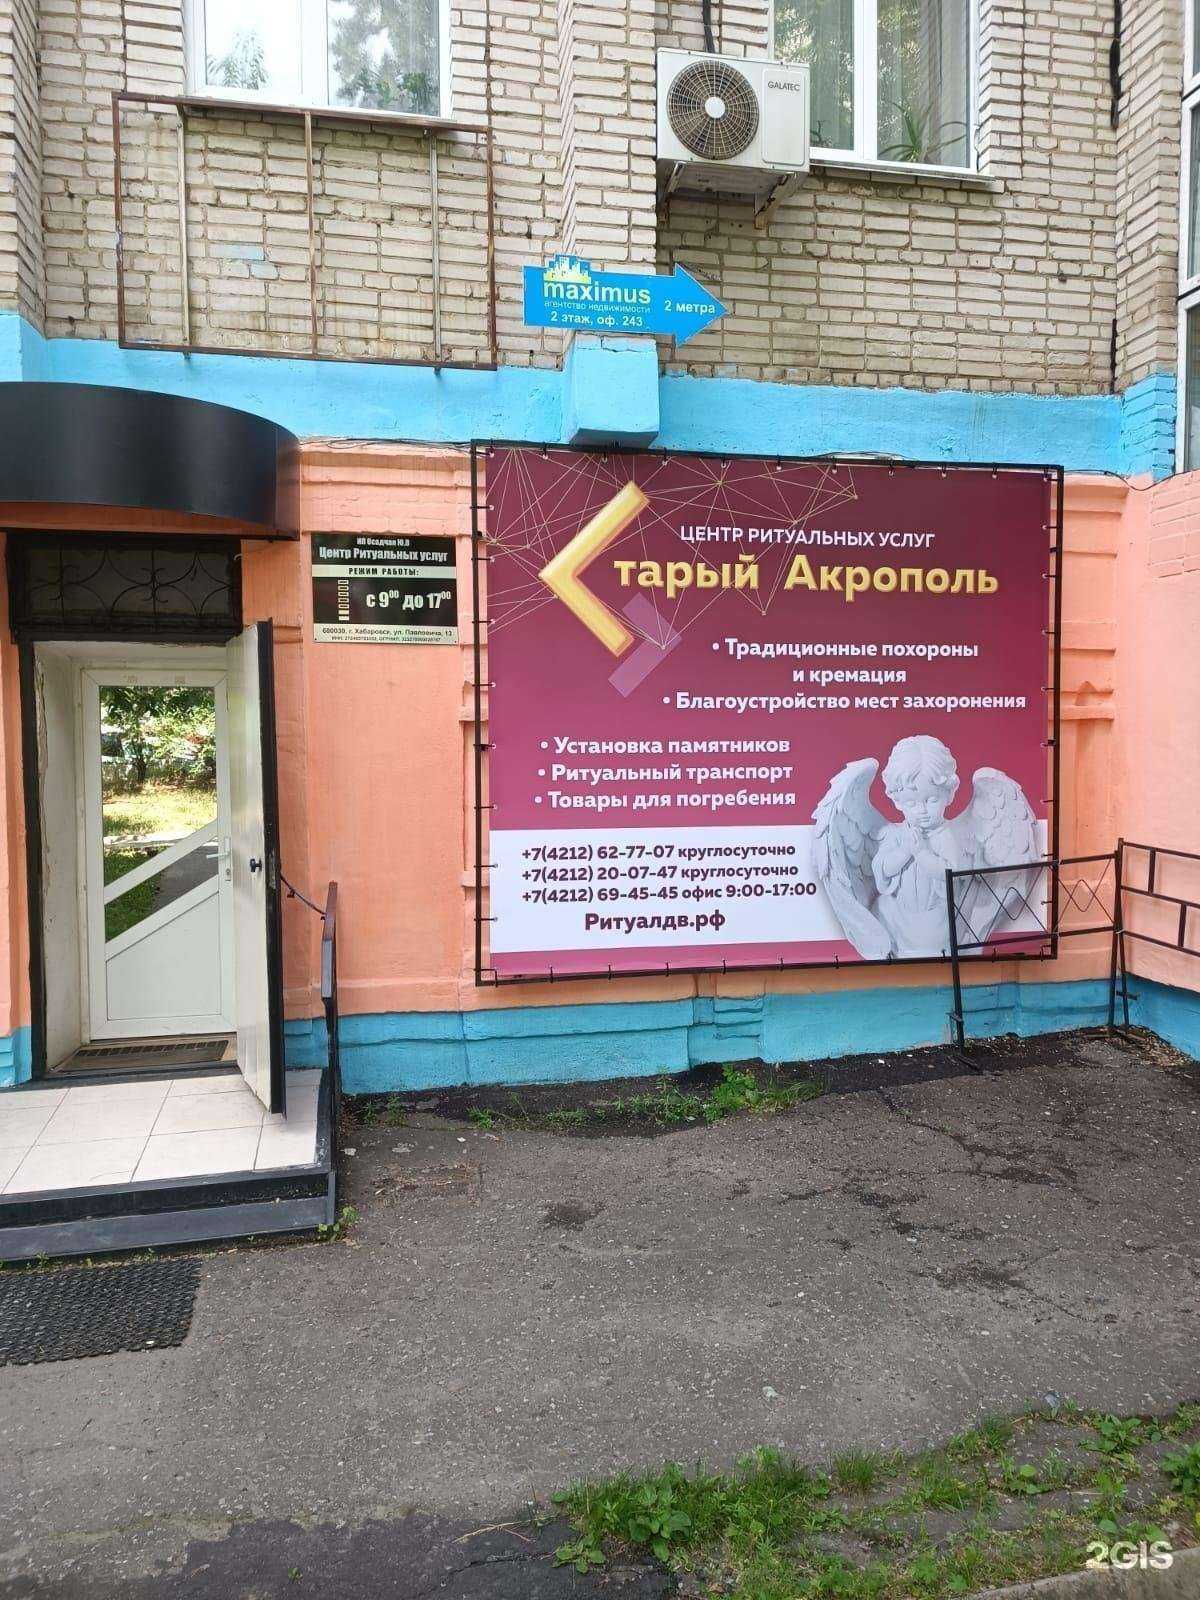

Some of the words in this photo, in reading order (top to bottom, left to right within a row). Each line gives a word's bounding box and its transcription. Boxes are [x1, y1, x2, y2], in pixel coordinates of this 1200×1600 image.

[767, 80, 801, 91] GALATEC
[543, 280, 651, 304] maximus
[544, 301, 587, 310] агентство
[588, 303, 651, 313] недвижимости
[664, 299, 673, 311] 2
[676, 302, 716, 315] метра
[550, 310, 558, 321] 2
[561, 313, 593, 325] этаж,
[597, 315, 619, 327] оф.
[622, 315, 643, 327] 243
[680, 525, 743, 543] ЦЕНТР
[748, 527, 875, 547] РИТУАЛЬНЫХ
[878, 532, 935, 548] УСЛУГ
[319, 546, 352, 560] Центр
[353, 547, 419, 561] Ритуальных
[419, 551, 449, 563] услуг
[348, 567, 378, 576] РЕЖИМ
[382, 568, 419, 576] РАБОТЫ:
[784, 553, 1000, 602] Акрополь
[402, 594, 424, 611] до
[724, 638, 877, 660] Традиционные
[881, 643, 979, 661] похороны
[792, 668, 805, 683] и
[808, 667, 908, 686] кремация
[675, 692, 850, 714] Благоустройство
[853, 693, 900, 709] мест
[902, 695, 1027, 712] захоронения
[554, 737, 664, 755] Установка
[668, 739, 791, 753] памятников
[551, 764, 682, 785] Ритуальный
[686, 765, 793, 784] транспорт
[548, 791, 628, 812] Товары
[632, 795, 671, 810] для
[676, 789, 796, 810] погребения
[522, 845, 593, 862] +7(4212)
[597, 845, 675, 860] 62-77-07
[678, 845, 796, 860] круглосуточно
[522, 866, 594, 883] +7(4212)
[597, 866, 678, 880] 20-07-47
[681, 865, 799, 880] круглосуточно
[522, 887, 594, 904] +7(4212)
[597, 887, 678, 901] 69-45-45
[681, 888, 722, 902] офис
[725, 882, 817, 897] 9:00-17:00
[584, 909, 726, 934] Ритуалдв.рф
